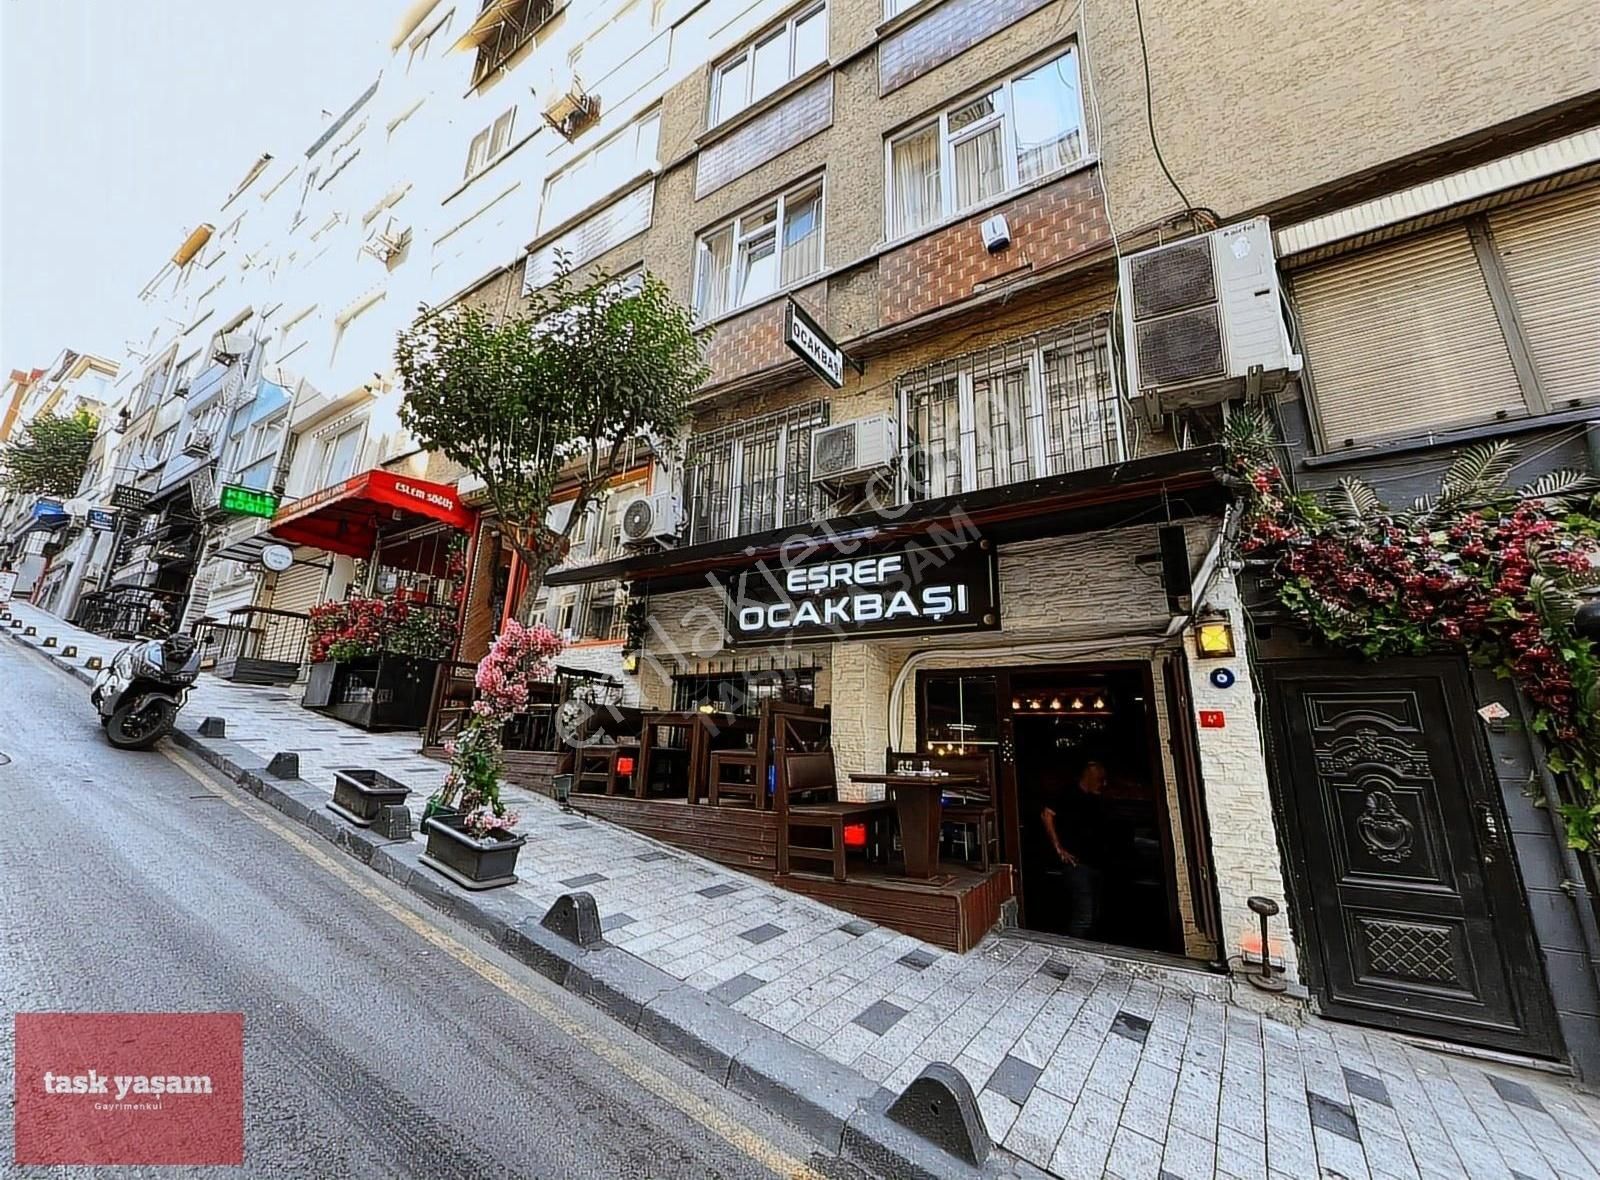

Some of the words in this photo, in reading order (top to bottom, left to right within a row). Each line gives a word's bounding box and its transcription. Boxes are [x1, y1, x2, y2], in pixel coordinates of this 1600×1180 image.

[226, 488, 274, 507] KELLE
[786, 555, 903, 594] EŞREF
[738, 584, 966, 631] OCAKBAŞI
